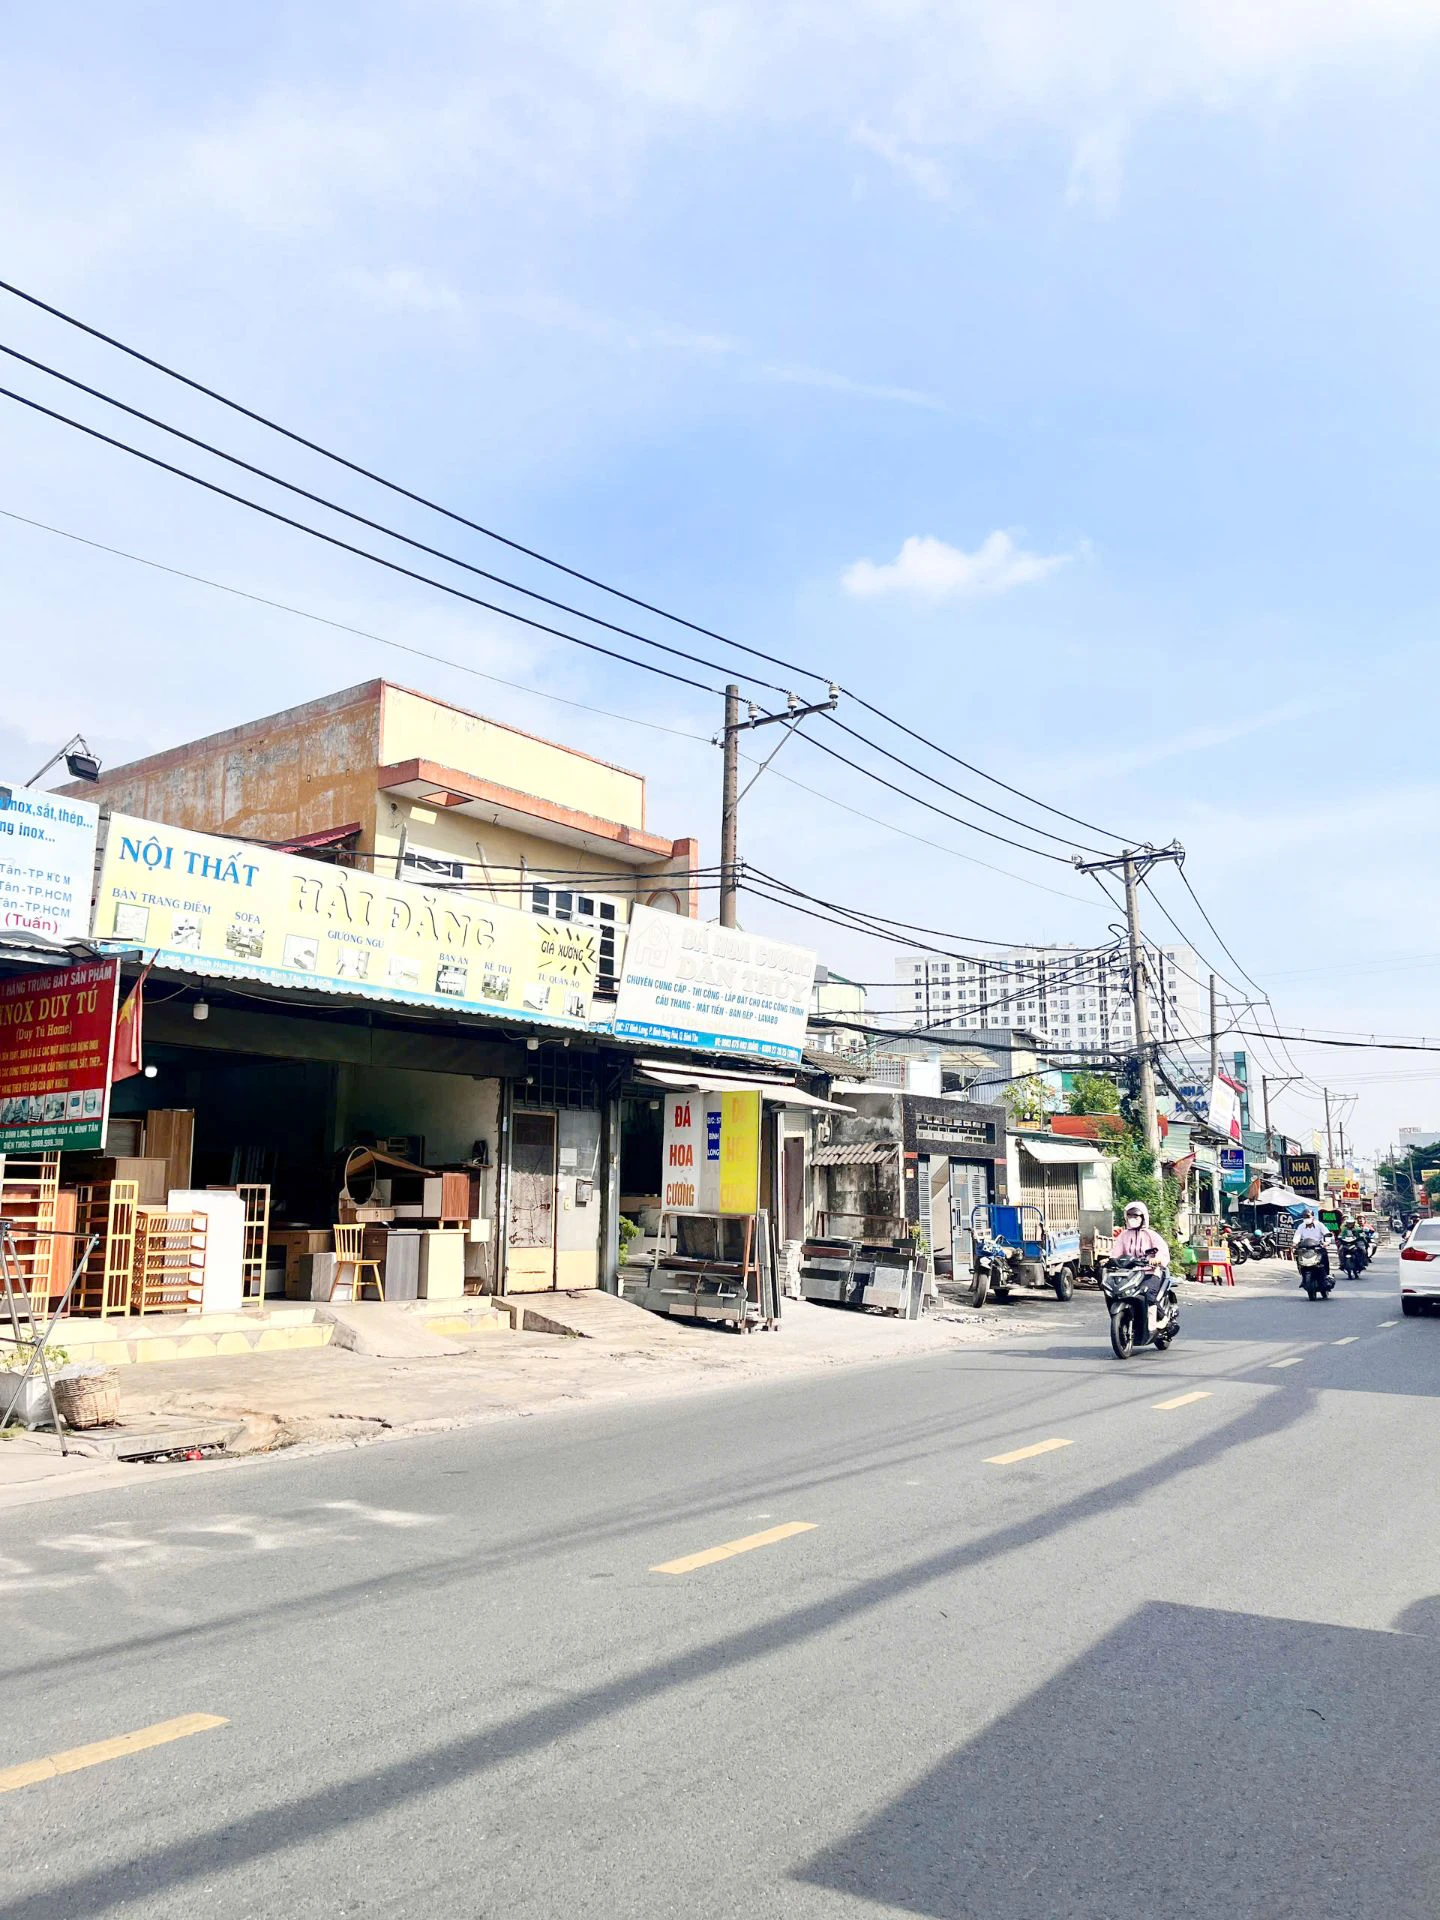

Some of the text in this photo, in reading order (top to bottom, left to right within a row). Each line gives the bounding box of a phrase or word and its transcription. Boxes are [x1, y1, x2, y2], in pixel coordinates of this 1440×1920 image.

[119, 835, 260, 887] NỘI THẤT
[141, 892, 181, 909] TRANG
[5, 911, 59, 934] (Tuấn)
[235, 911, 261, 924] SOFA
[655, 979, 673, 992] CUNG
[692, 986, 702, 997] THI
[38, 993, 73, 1021] DUY
[76, 983, 99, 1015] TÚ
[670, 997, 692, 1011] THANG
[47, 1020, 73, 1037] Home)
[675, 1100, 692, 1128] ĐÁ
[669, 1144, 694, 1167] HOA
[707, 1148, 720, 1156] LONG
[1292, 1162, 1311, 1172] NHA
[1290, 1175, 1316, 1186] KHOA
